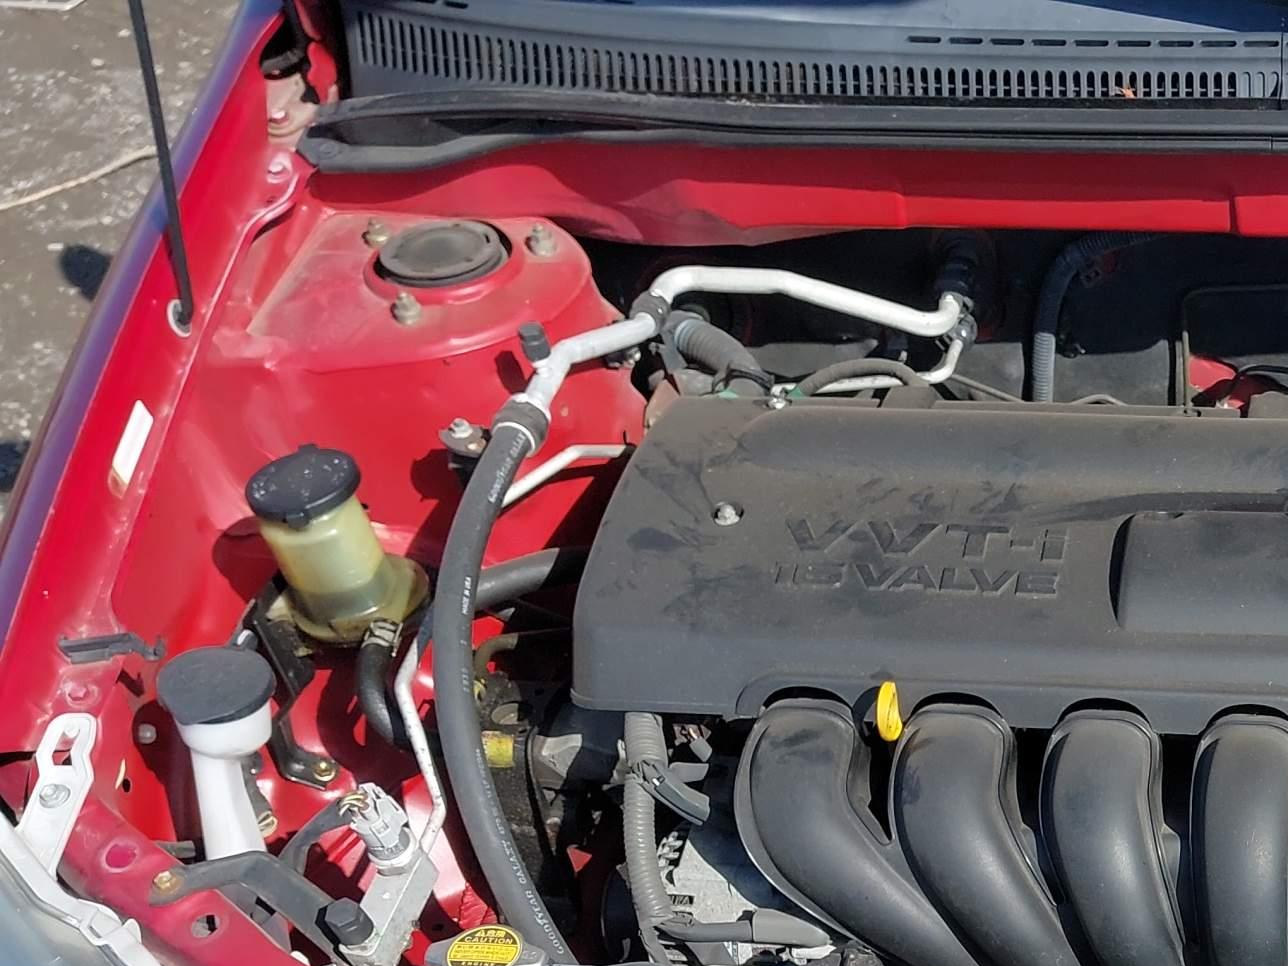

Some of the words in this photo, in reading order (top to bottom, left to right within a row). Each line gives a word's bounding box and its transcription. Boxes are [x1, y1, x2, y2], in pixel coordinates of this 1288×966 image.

[854, 563, 1060, 598] VALVE
[502, 839, 527, 885] GALAXY
[464, 936, 513, 945] CAUTION
[525, 890, 564, 954] GOODYEAR
